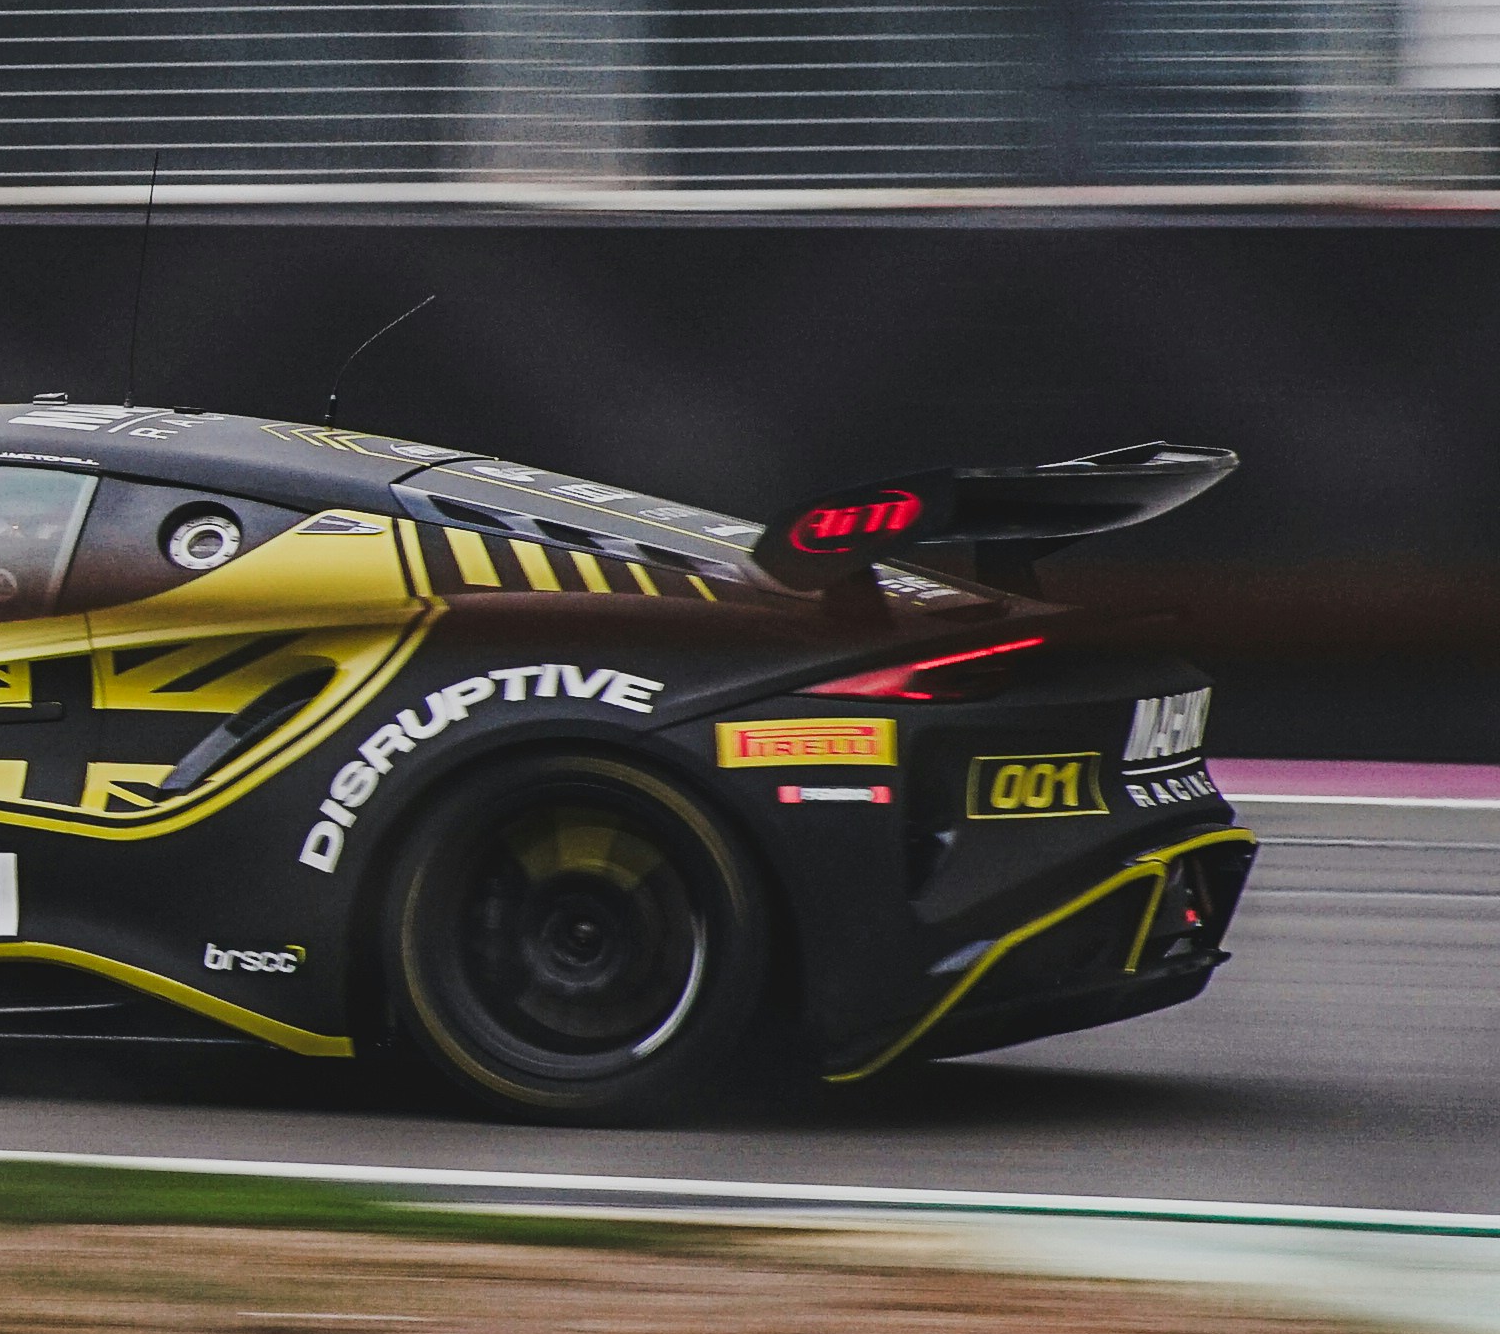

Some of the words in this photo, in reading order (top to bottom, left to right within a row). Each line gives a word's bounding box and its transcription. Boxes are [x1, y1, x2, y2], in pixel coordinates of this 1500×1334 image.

[735, 726, 878, 757] PIRELLI
[299, 663, 665, 874] DISRUPTIVE
[990, 762, 1082, 810] 001
[203, 943, 298, 973] brscc
